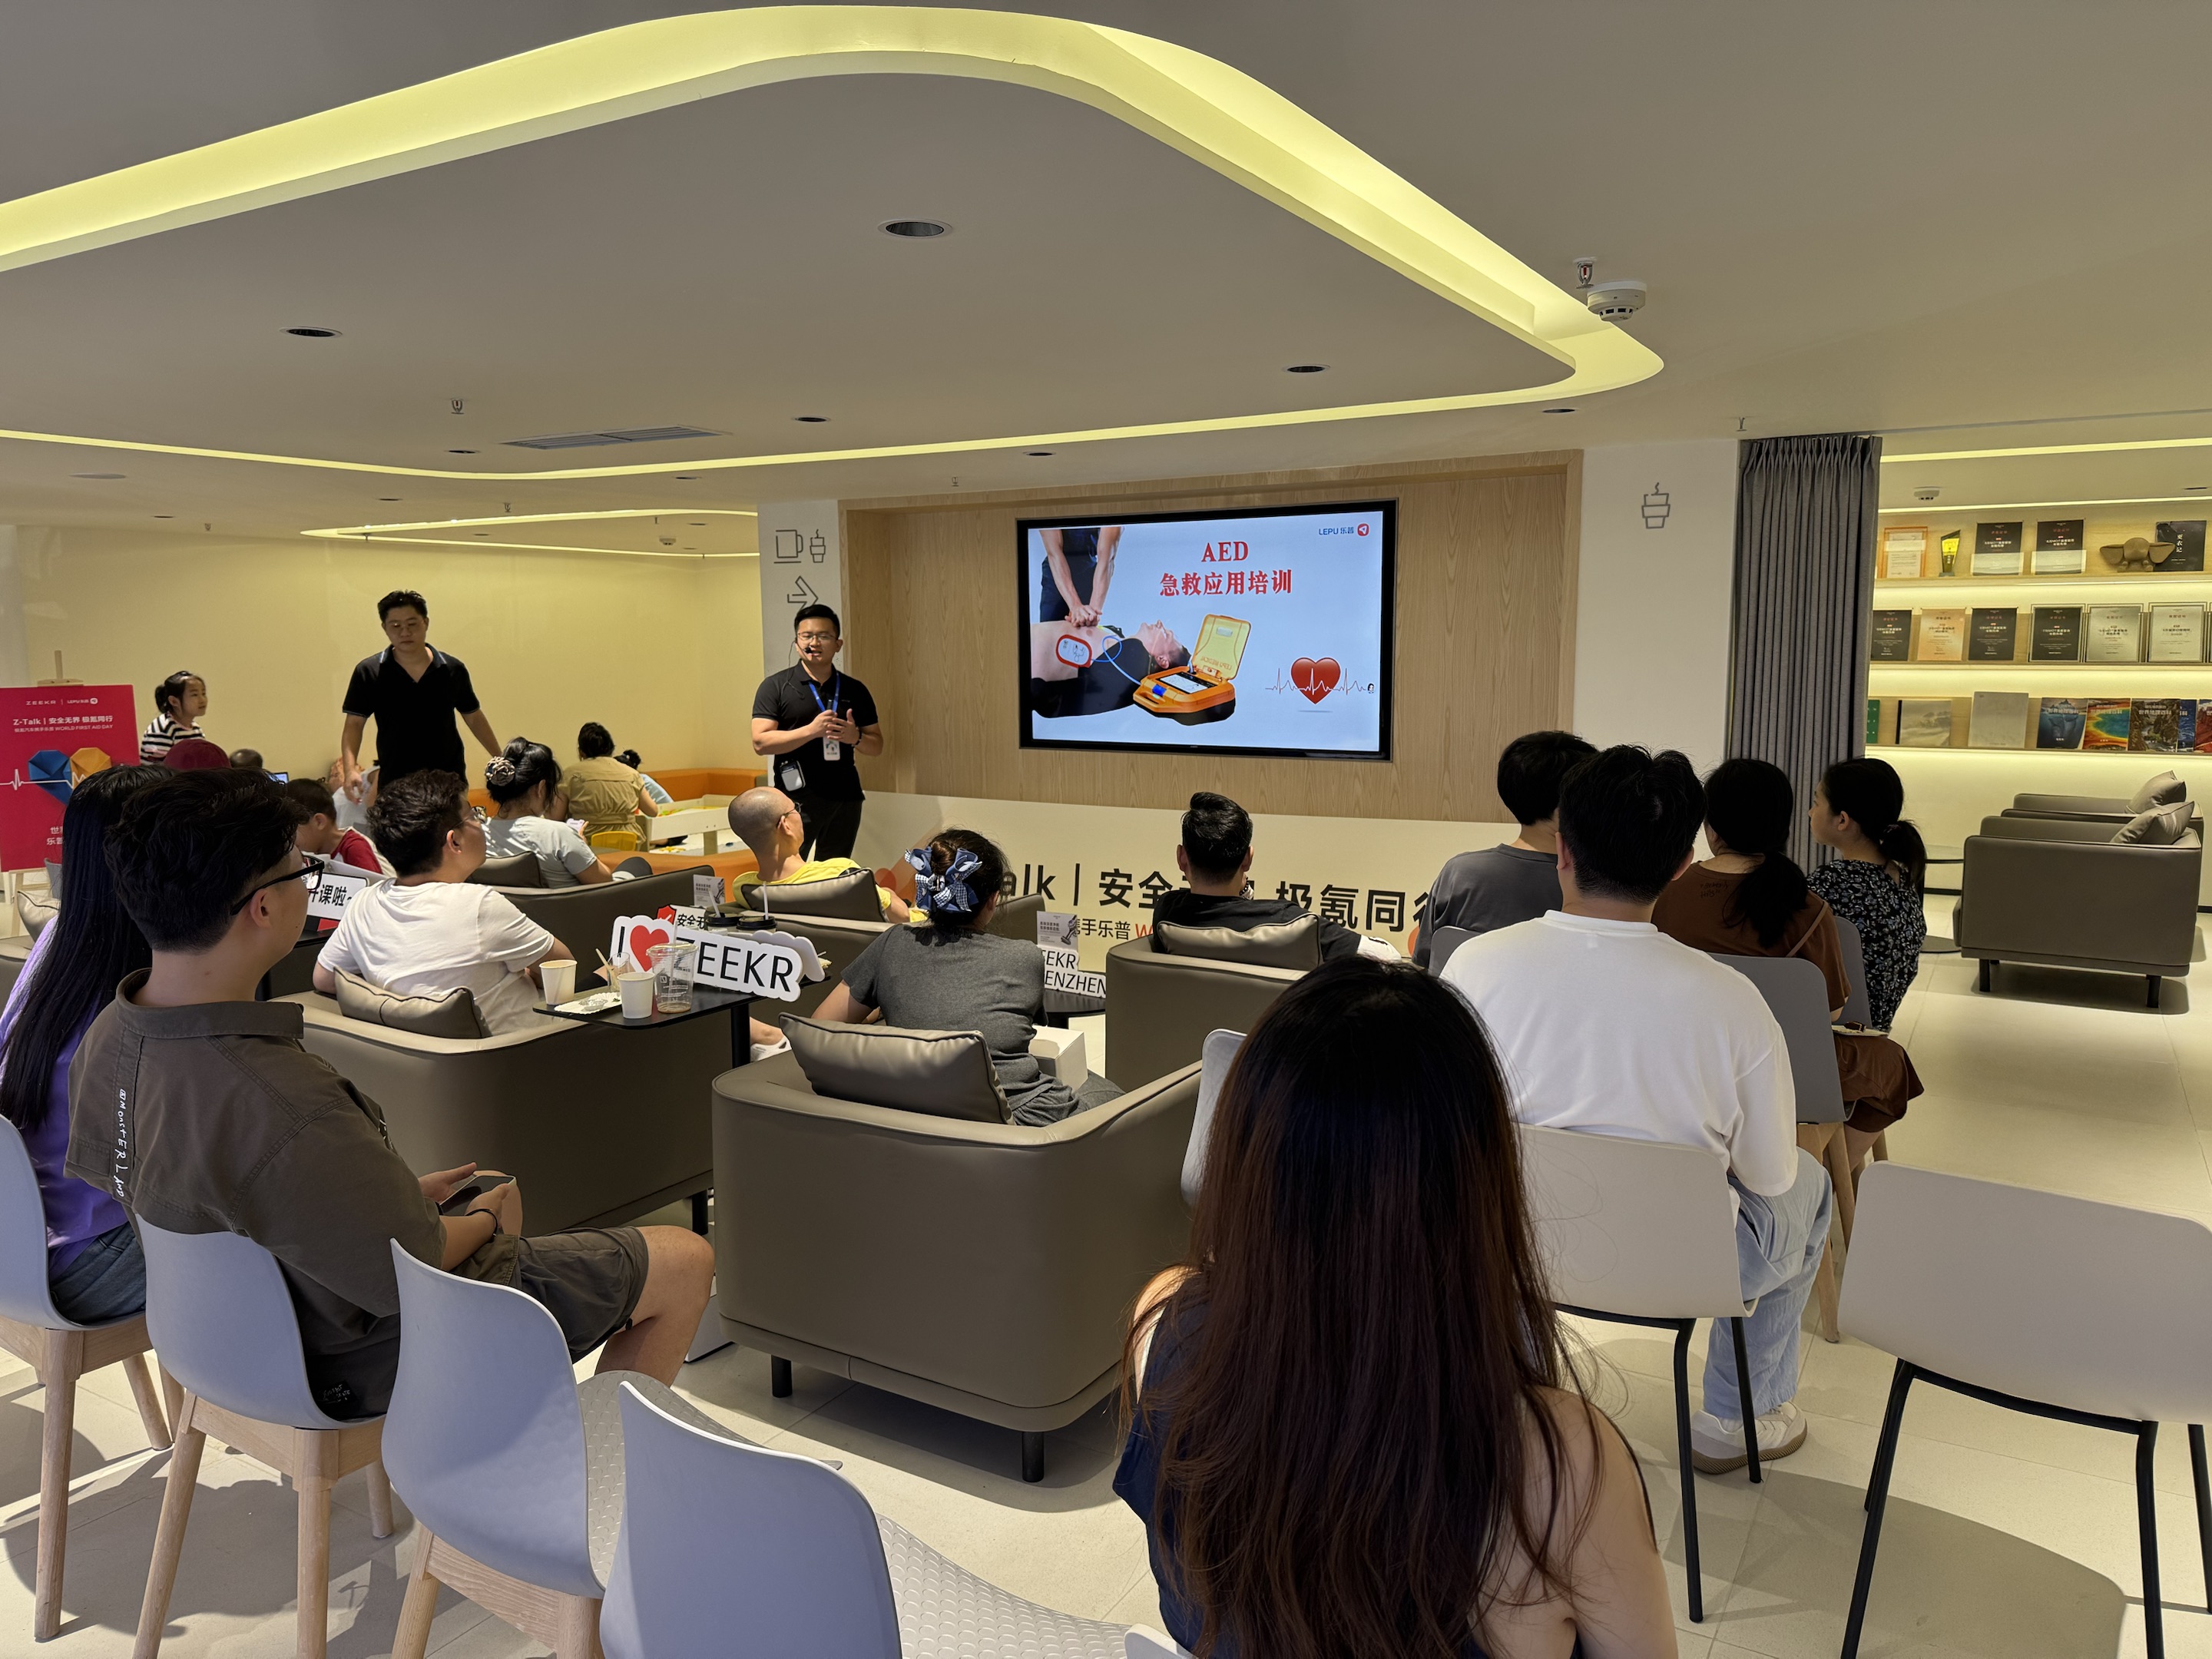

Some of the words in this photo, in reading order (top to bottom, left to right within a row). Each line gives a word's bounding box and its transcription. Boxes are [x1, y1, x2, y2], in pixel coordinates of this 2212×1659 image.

[1201, 541, 1249, 562] AED
[1160, 569, 1292, 597] 急救应用培训
[1000, 864, 1056, 900] alk
[677, 913, 705, 929] 安全无
[618, 926, 625, 958] I
[674, 936, 793, 992] ZEEKR
[1041, 949, 1077, 970] EKR
[1044, 970, 1106, 995] ENZHEN
